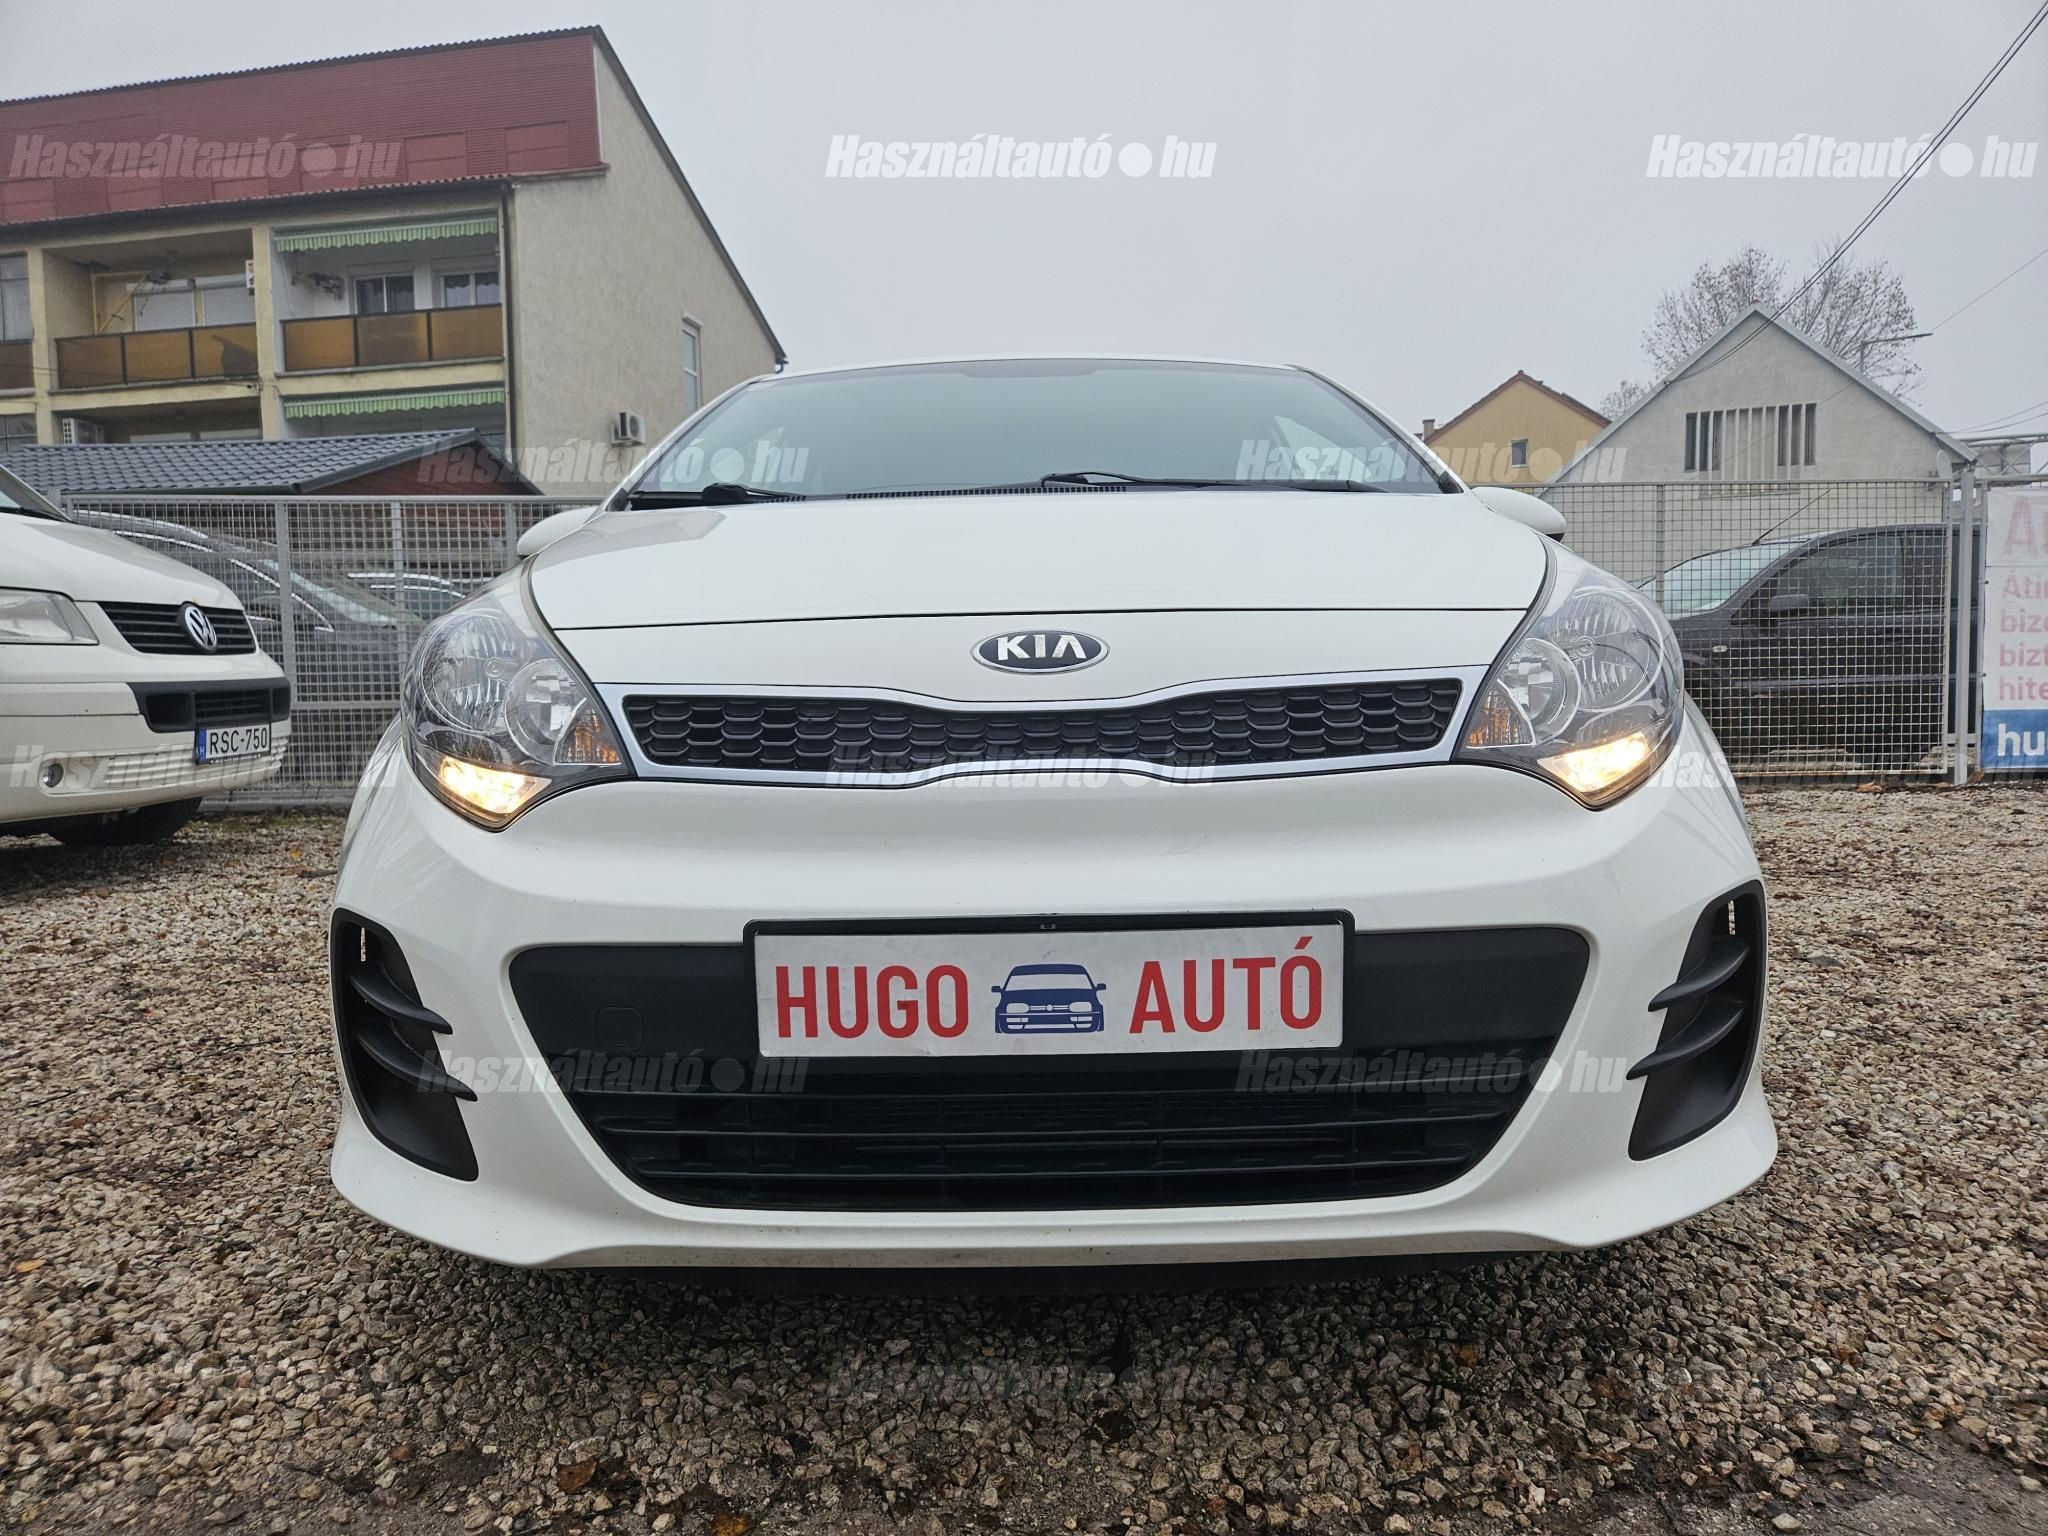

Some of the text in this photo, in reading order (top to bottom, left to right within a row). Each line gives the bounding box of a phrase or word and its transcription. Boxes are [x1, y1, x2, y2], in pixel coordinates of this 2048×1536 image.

[997, 634, 1087, 660] KIA
[210, 727, 268, 755] RSC-750
[775, 936, 1323, 1039] HUGO AUTÓ
